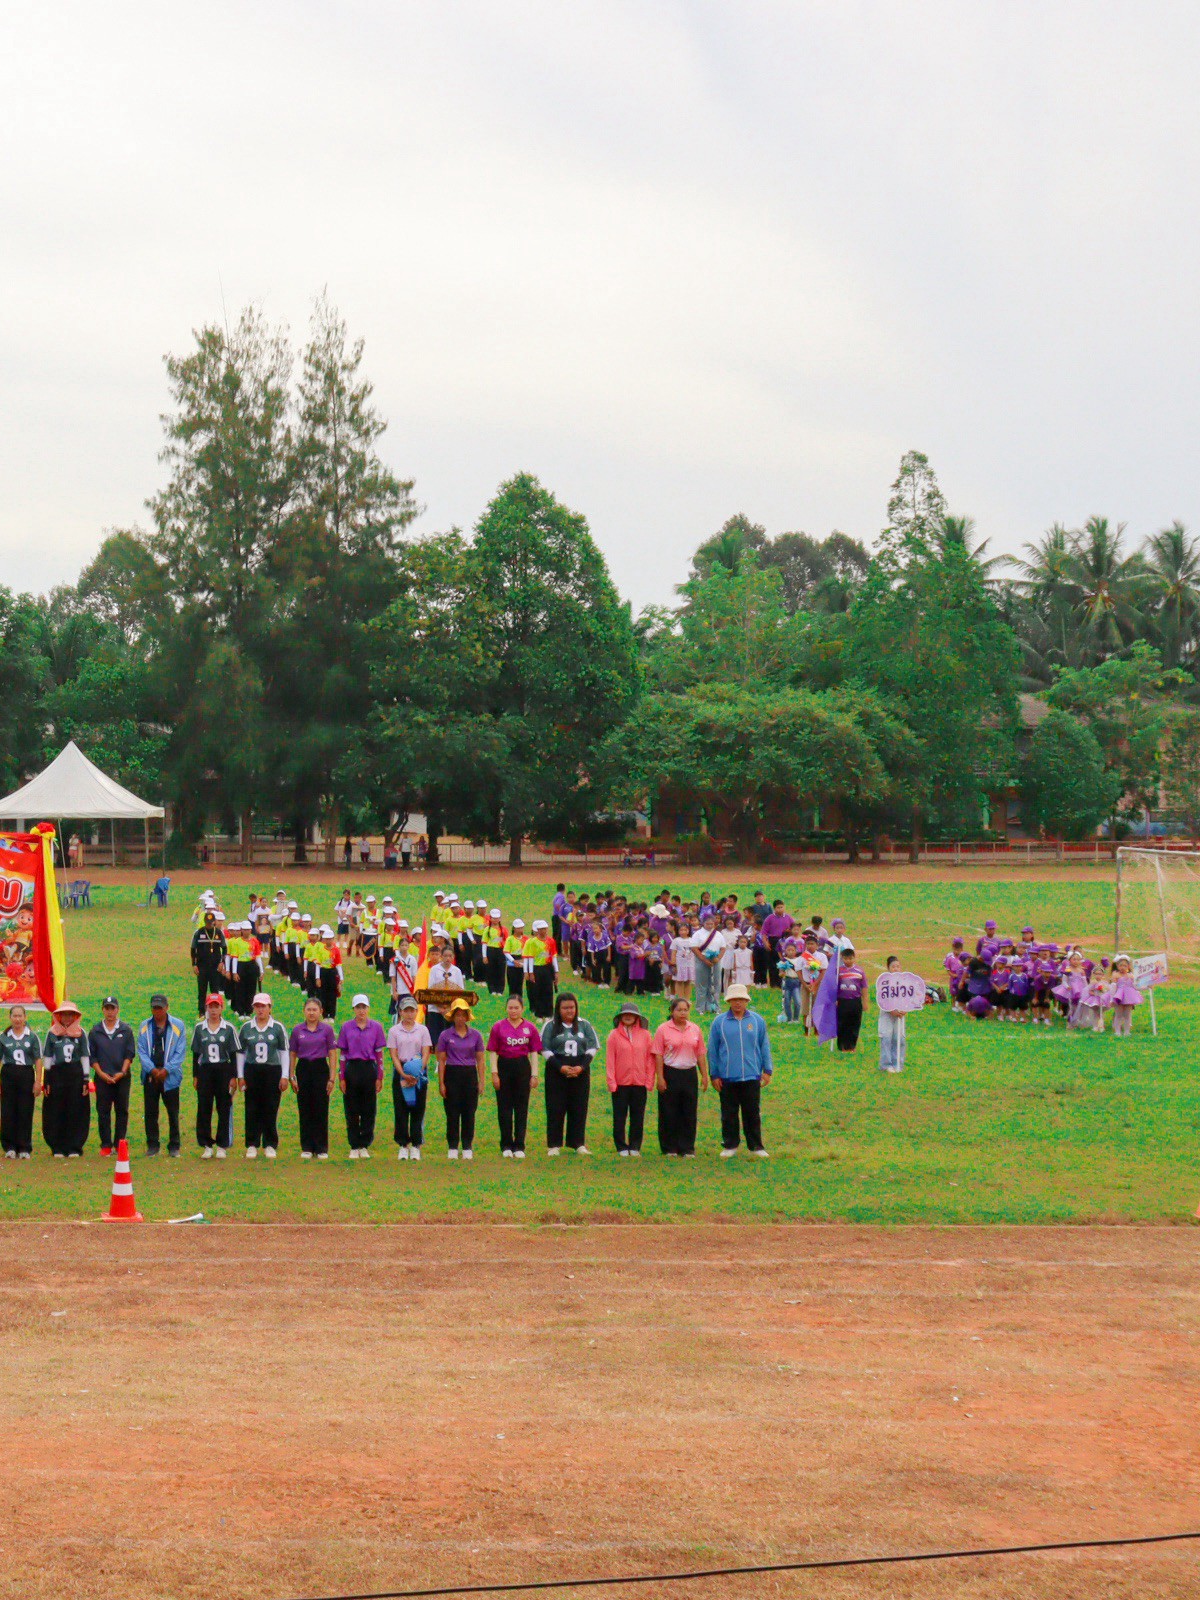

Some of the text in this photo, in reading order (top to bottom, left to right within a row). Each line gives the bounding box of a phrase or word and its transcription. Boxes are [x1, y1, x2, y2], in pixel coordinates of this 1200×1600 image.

[881, 980, 914, 999] สีม่วง
[63, 1044, 74, 1062] 9
[208, 1043, 220, 1063] 9
[255, 1042, 268, 1063] 9
